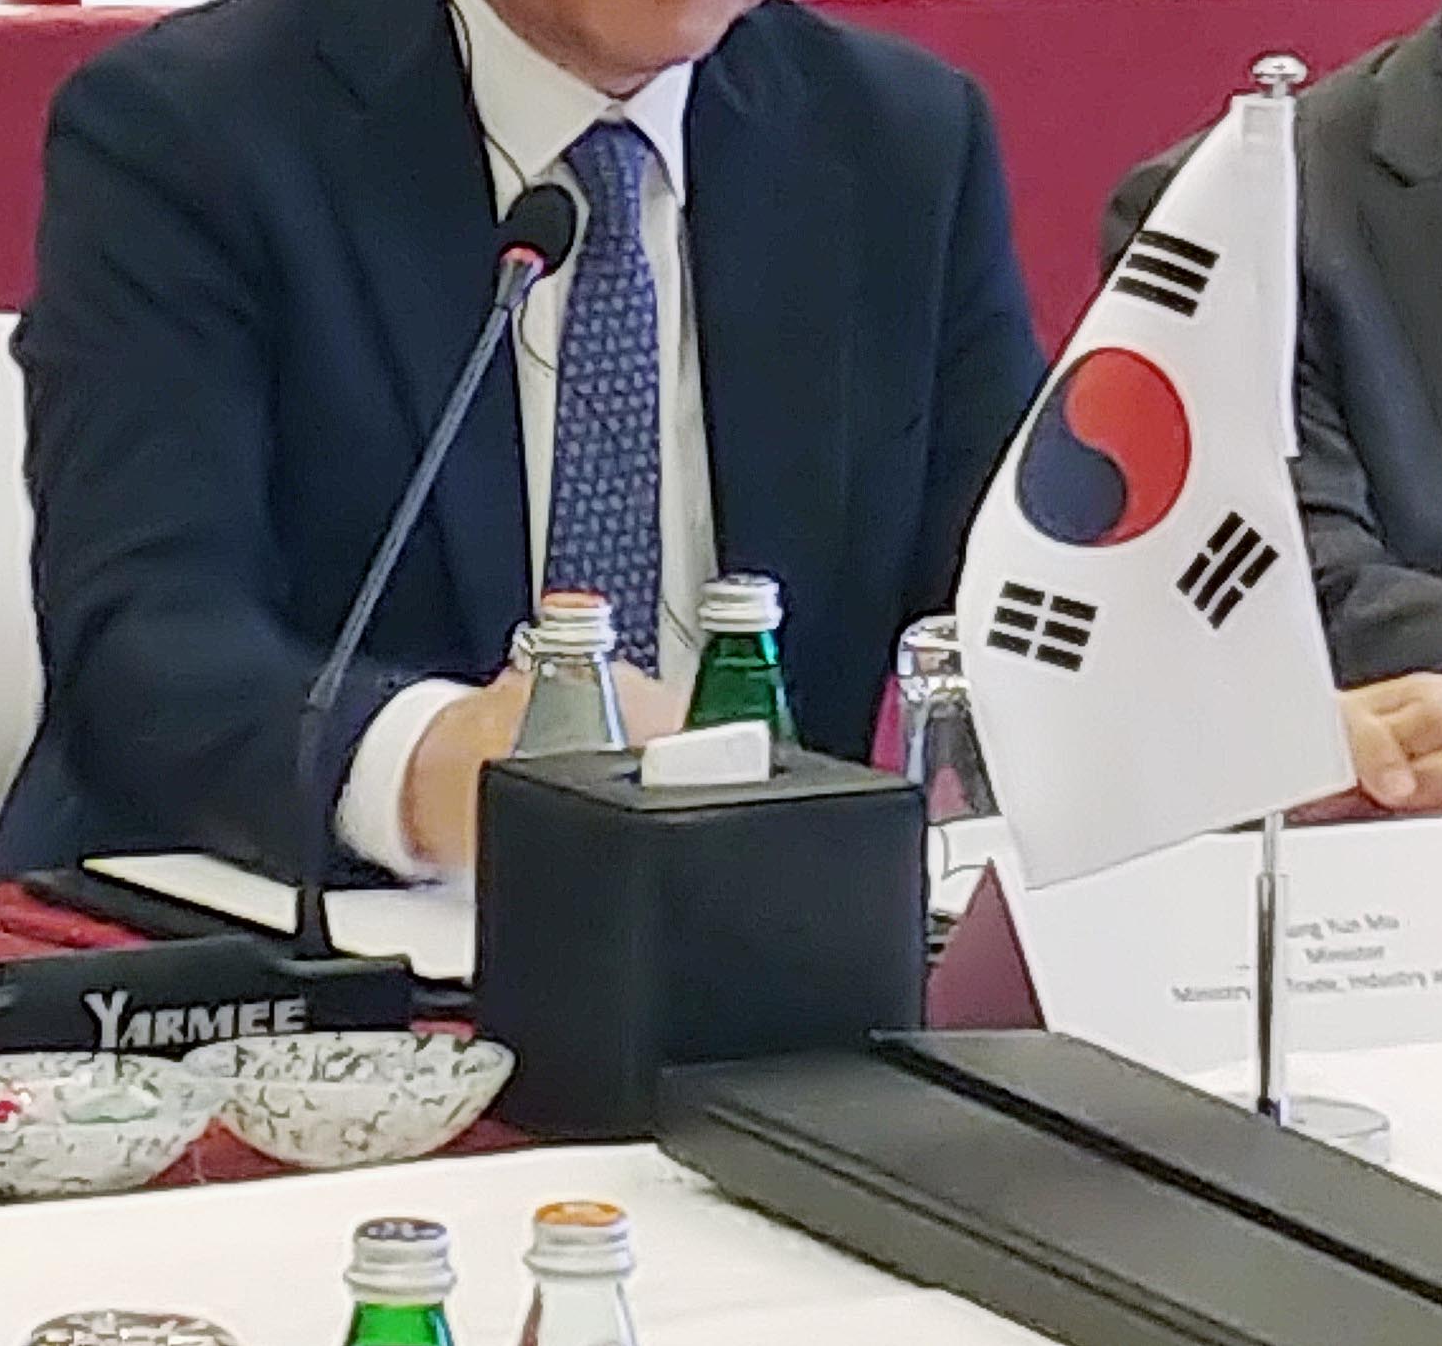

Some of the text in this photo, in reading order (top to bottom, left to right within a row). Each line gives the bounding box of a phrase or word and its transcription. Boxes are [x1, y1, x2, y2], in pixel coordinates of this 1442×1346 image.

[1304, 945, 1385, 964] Minister
[1172, 984, 1252, 1003] Ministry
[83, 989, 307, 1049] YARMEE
